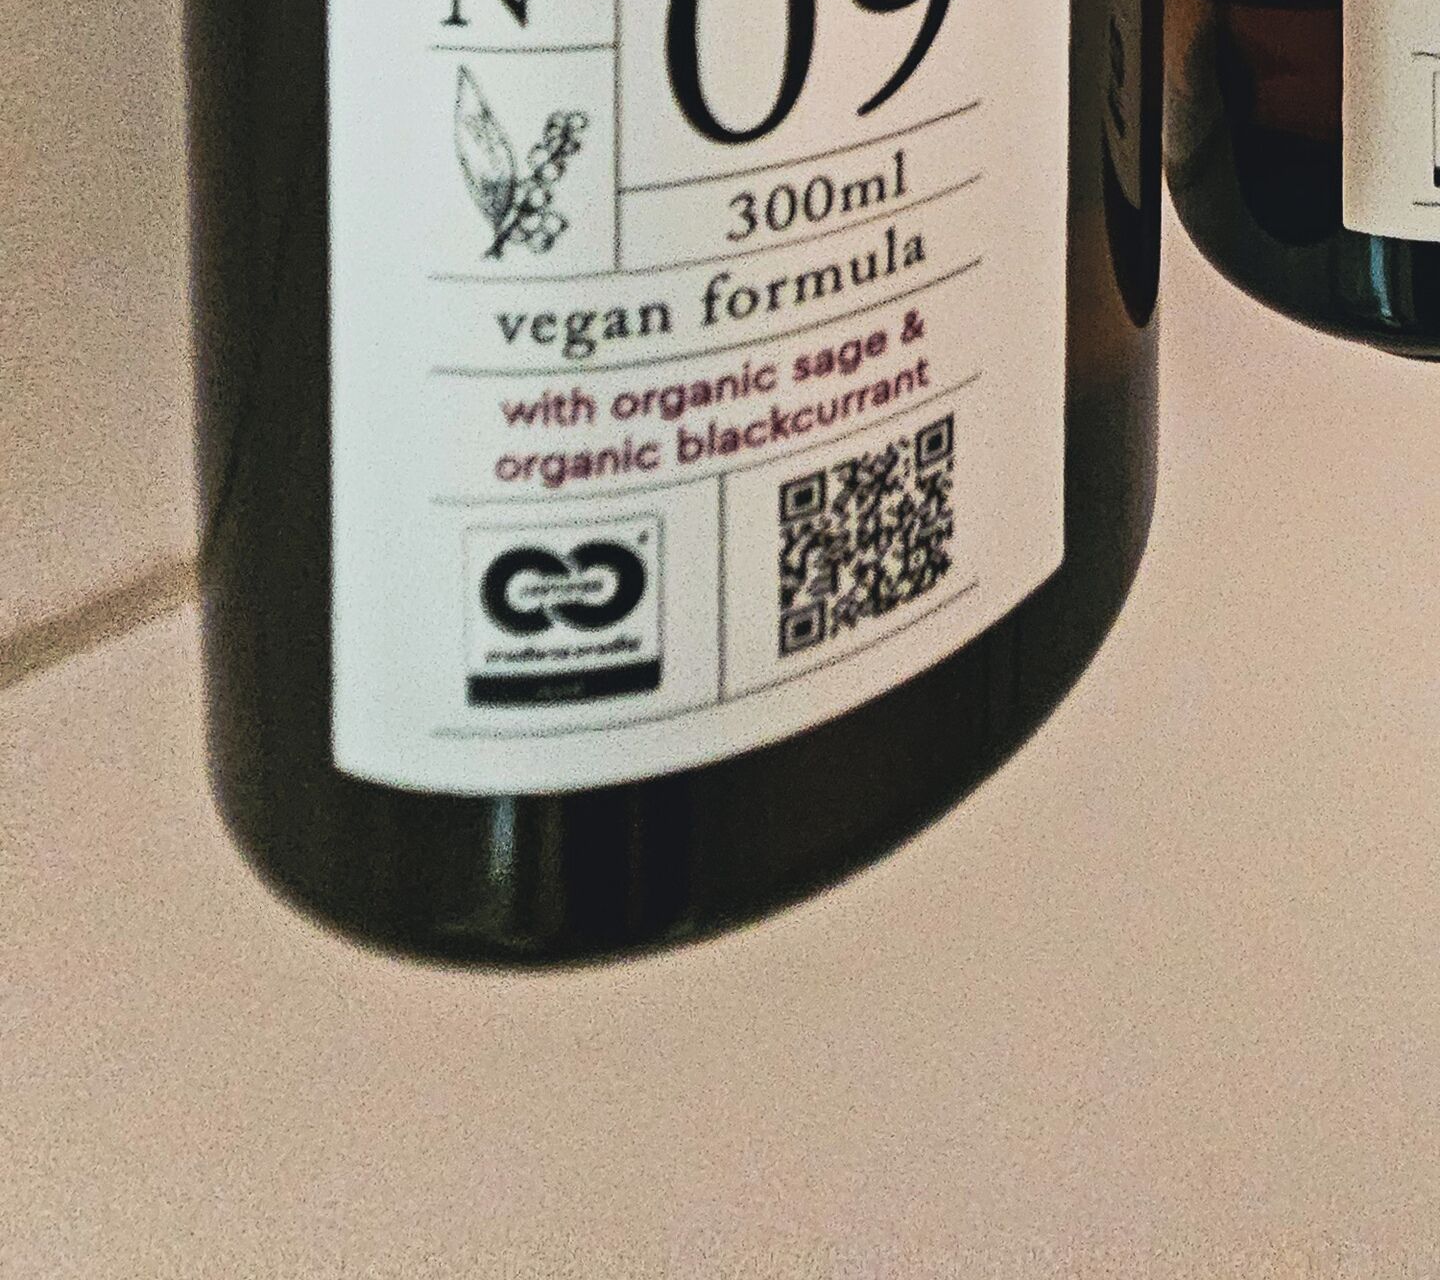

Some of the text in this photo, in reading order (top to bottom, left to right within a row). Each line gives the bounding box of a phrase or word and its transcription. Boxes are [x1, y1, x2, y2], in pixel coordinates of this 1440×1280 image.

[726, 151, 908, 242] 300ml
[496, 226, 926, 358] vegan formula
[495, 356, 929, 488] organic blackcurrant
[501, 309, 925, 427] with organic sage &
